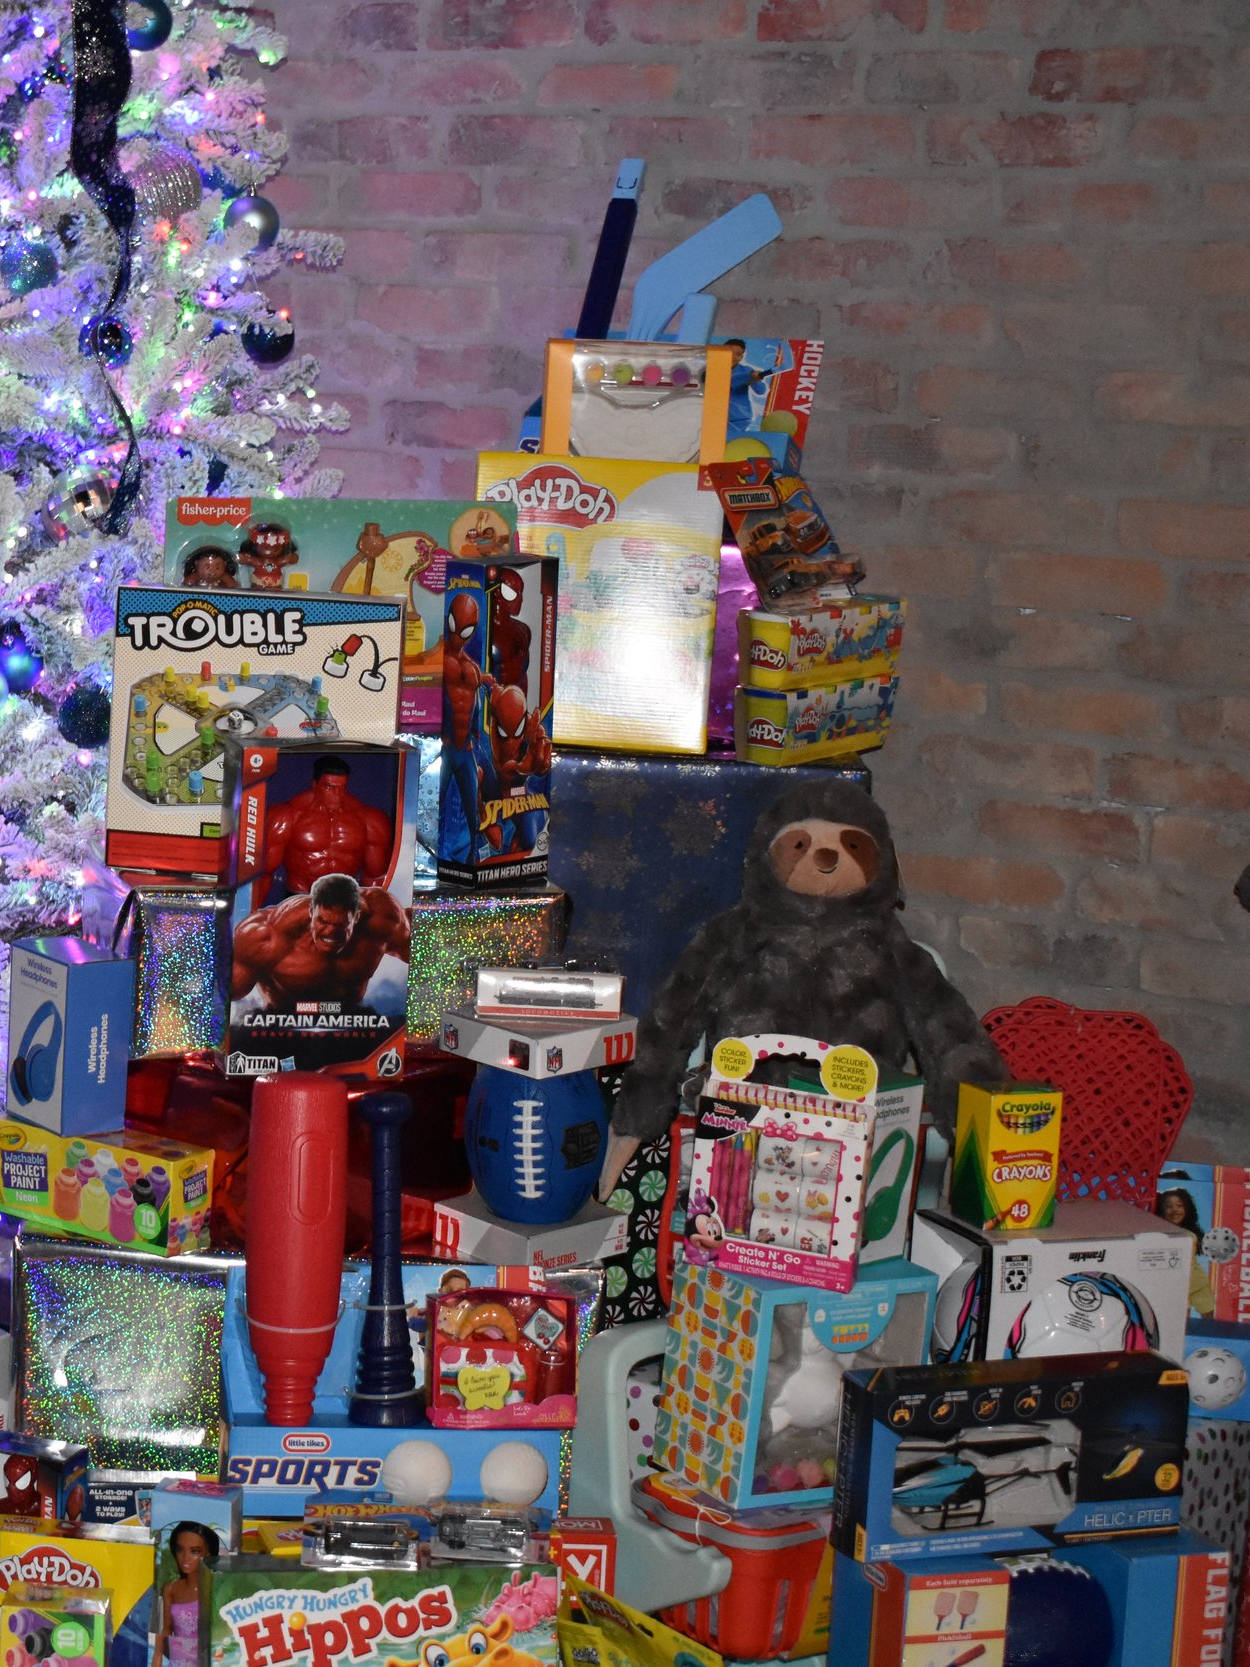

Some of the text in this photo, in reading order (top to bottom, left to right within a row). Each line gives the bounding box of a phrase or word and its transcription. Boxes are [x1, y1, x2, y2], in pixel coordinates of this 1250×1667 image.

[792, 340, 825, 414] HOCKEY
[486, 475, 611, 524] Play-Doh
[728, 492, 772, 505] MATCHBOX
[181, 504, 247, 519] fisher-price
[172, 600, 218, 618] POP-O-MATIC
[128, 607, 305, 650] TROUBLE
[544, 596, 553, 673] SPIDER-MAN
[258, 643, 294, 655] GAME
[479, 792, 550, 831] SPIDER-MAN
[245, 795, 258, 865] RED HULK
[476, 860, 548, 882] TITAN HERO SERIES
[296, 1002, 341, 1012] MARVEL STUDIOS
[521, 1009, 575, 1017] LOCOMOTIVE
[243, 1014, 389, 1028] CAPTAIN AMERICA
[87, 1026, 99, 1074] Wireless
[98, 1013, 109, 1084] Headphones
[247, 1059, 276, 1070] TITAN
[719, 1055, 747, 1065] STICKER
[832, 1056, 869, 1068] INCLUDES
[724, 1064, 740, 1073] FUN!
[831, 1072, 867, 1085] CRAYONS
[839, 1083, 864, 1092] MORE!
[1001, 1100, 1054, 1115] Crayola
[4, 1152, 45, 1165] Washable
[3, 1163, 46, 1178] PROJECT
[992, 1164, 1052, 1182] CRAYONS
[11, 1176, 40, 1190] PAINT
[184, 1177, 207, 1195] PROJECT
[16, 1190, 39, 1203] Neon
[187, 1189, 204, 1200] PAINT
[140, 1208, 156, 1227] 10
[1010, 1203, 1029, 1218] 48
[533, 1249, 544, 1261] NFL
[556, 1252, 578, 1267] SERIES
[726, 1243, 765, 1259] Create
[782, 1253, 801, 1265] Go
[738, 1255, 787, 1272] Sticker Set
[288, 1438, 325, 1448] little tikes
[228, 1457, 383, 1493] SPORTS
[0, 1554, 95, 1588] Play-Doh
[225, 1582, 370, 1624] HUNGRY HUNGRY
[1200, 1551, 1230, 1667] FLAG FO
[236, 1589, 454, 1667] Hippos
